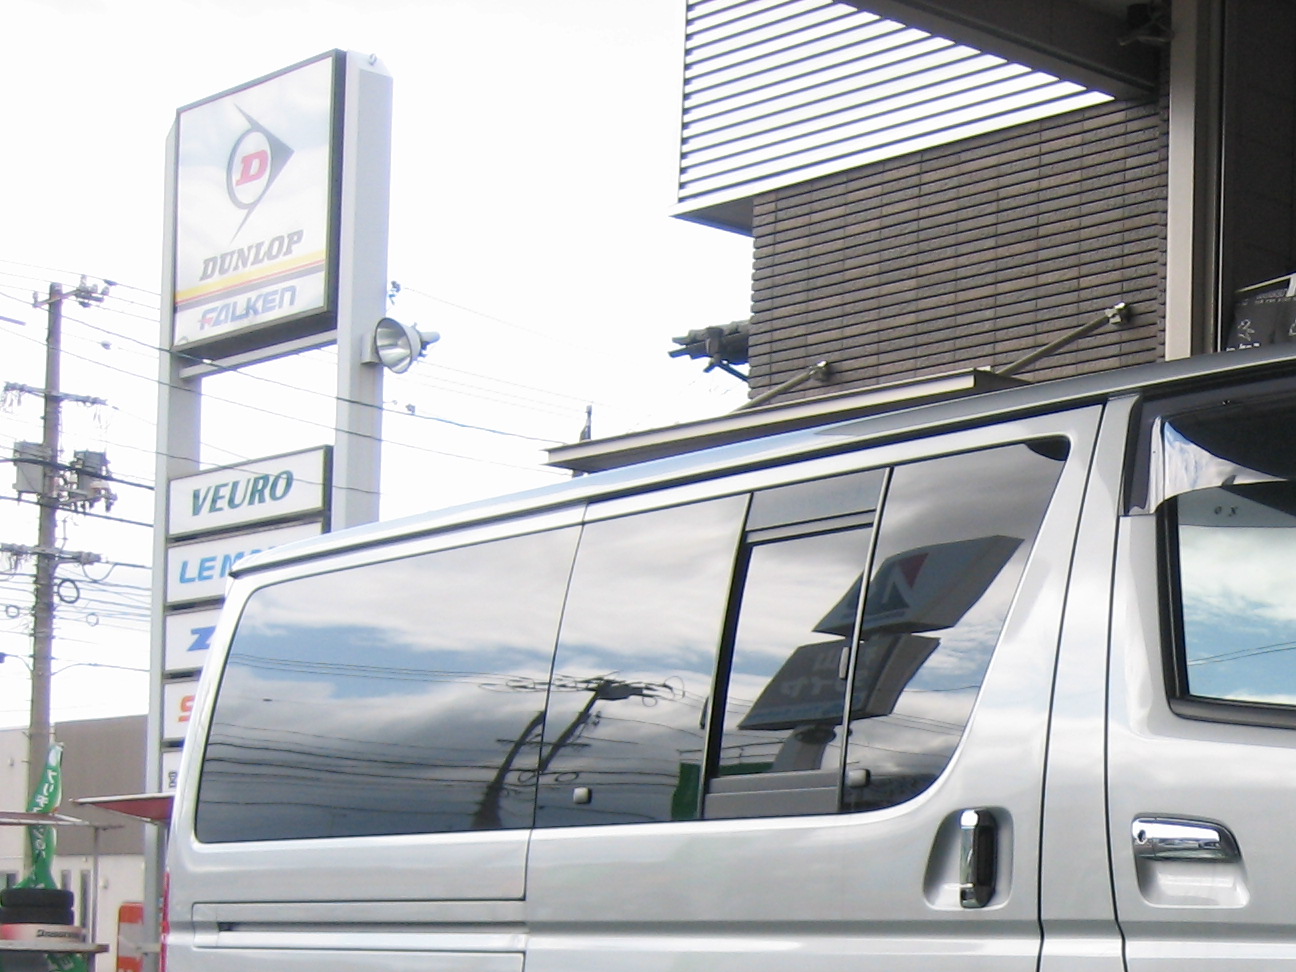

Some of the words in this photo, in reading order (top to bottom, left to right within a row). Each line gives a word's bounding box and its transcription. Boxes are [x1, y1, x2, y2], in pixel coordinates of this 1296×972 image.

[199, 229, 304, 282] DUNLOP
[197, 285, 297, 331] FALKEN
[191, 470, 294, 517] VEURO
